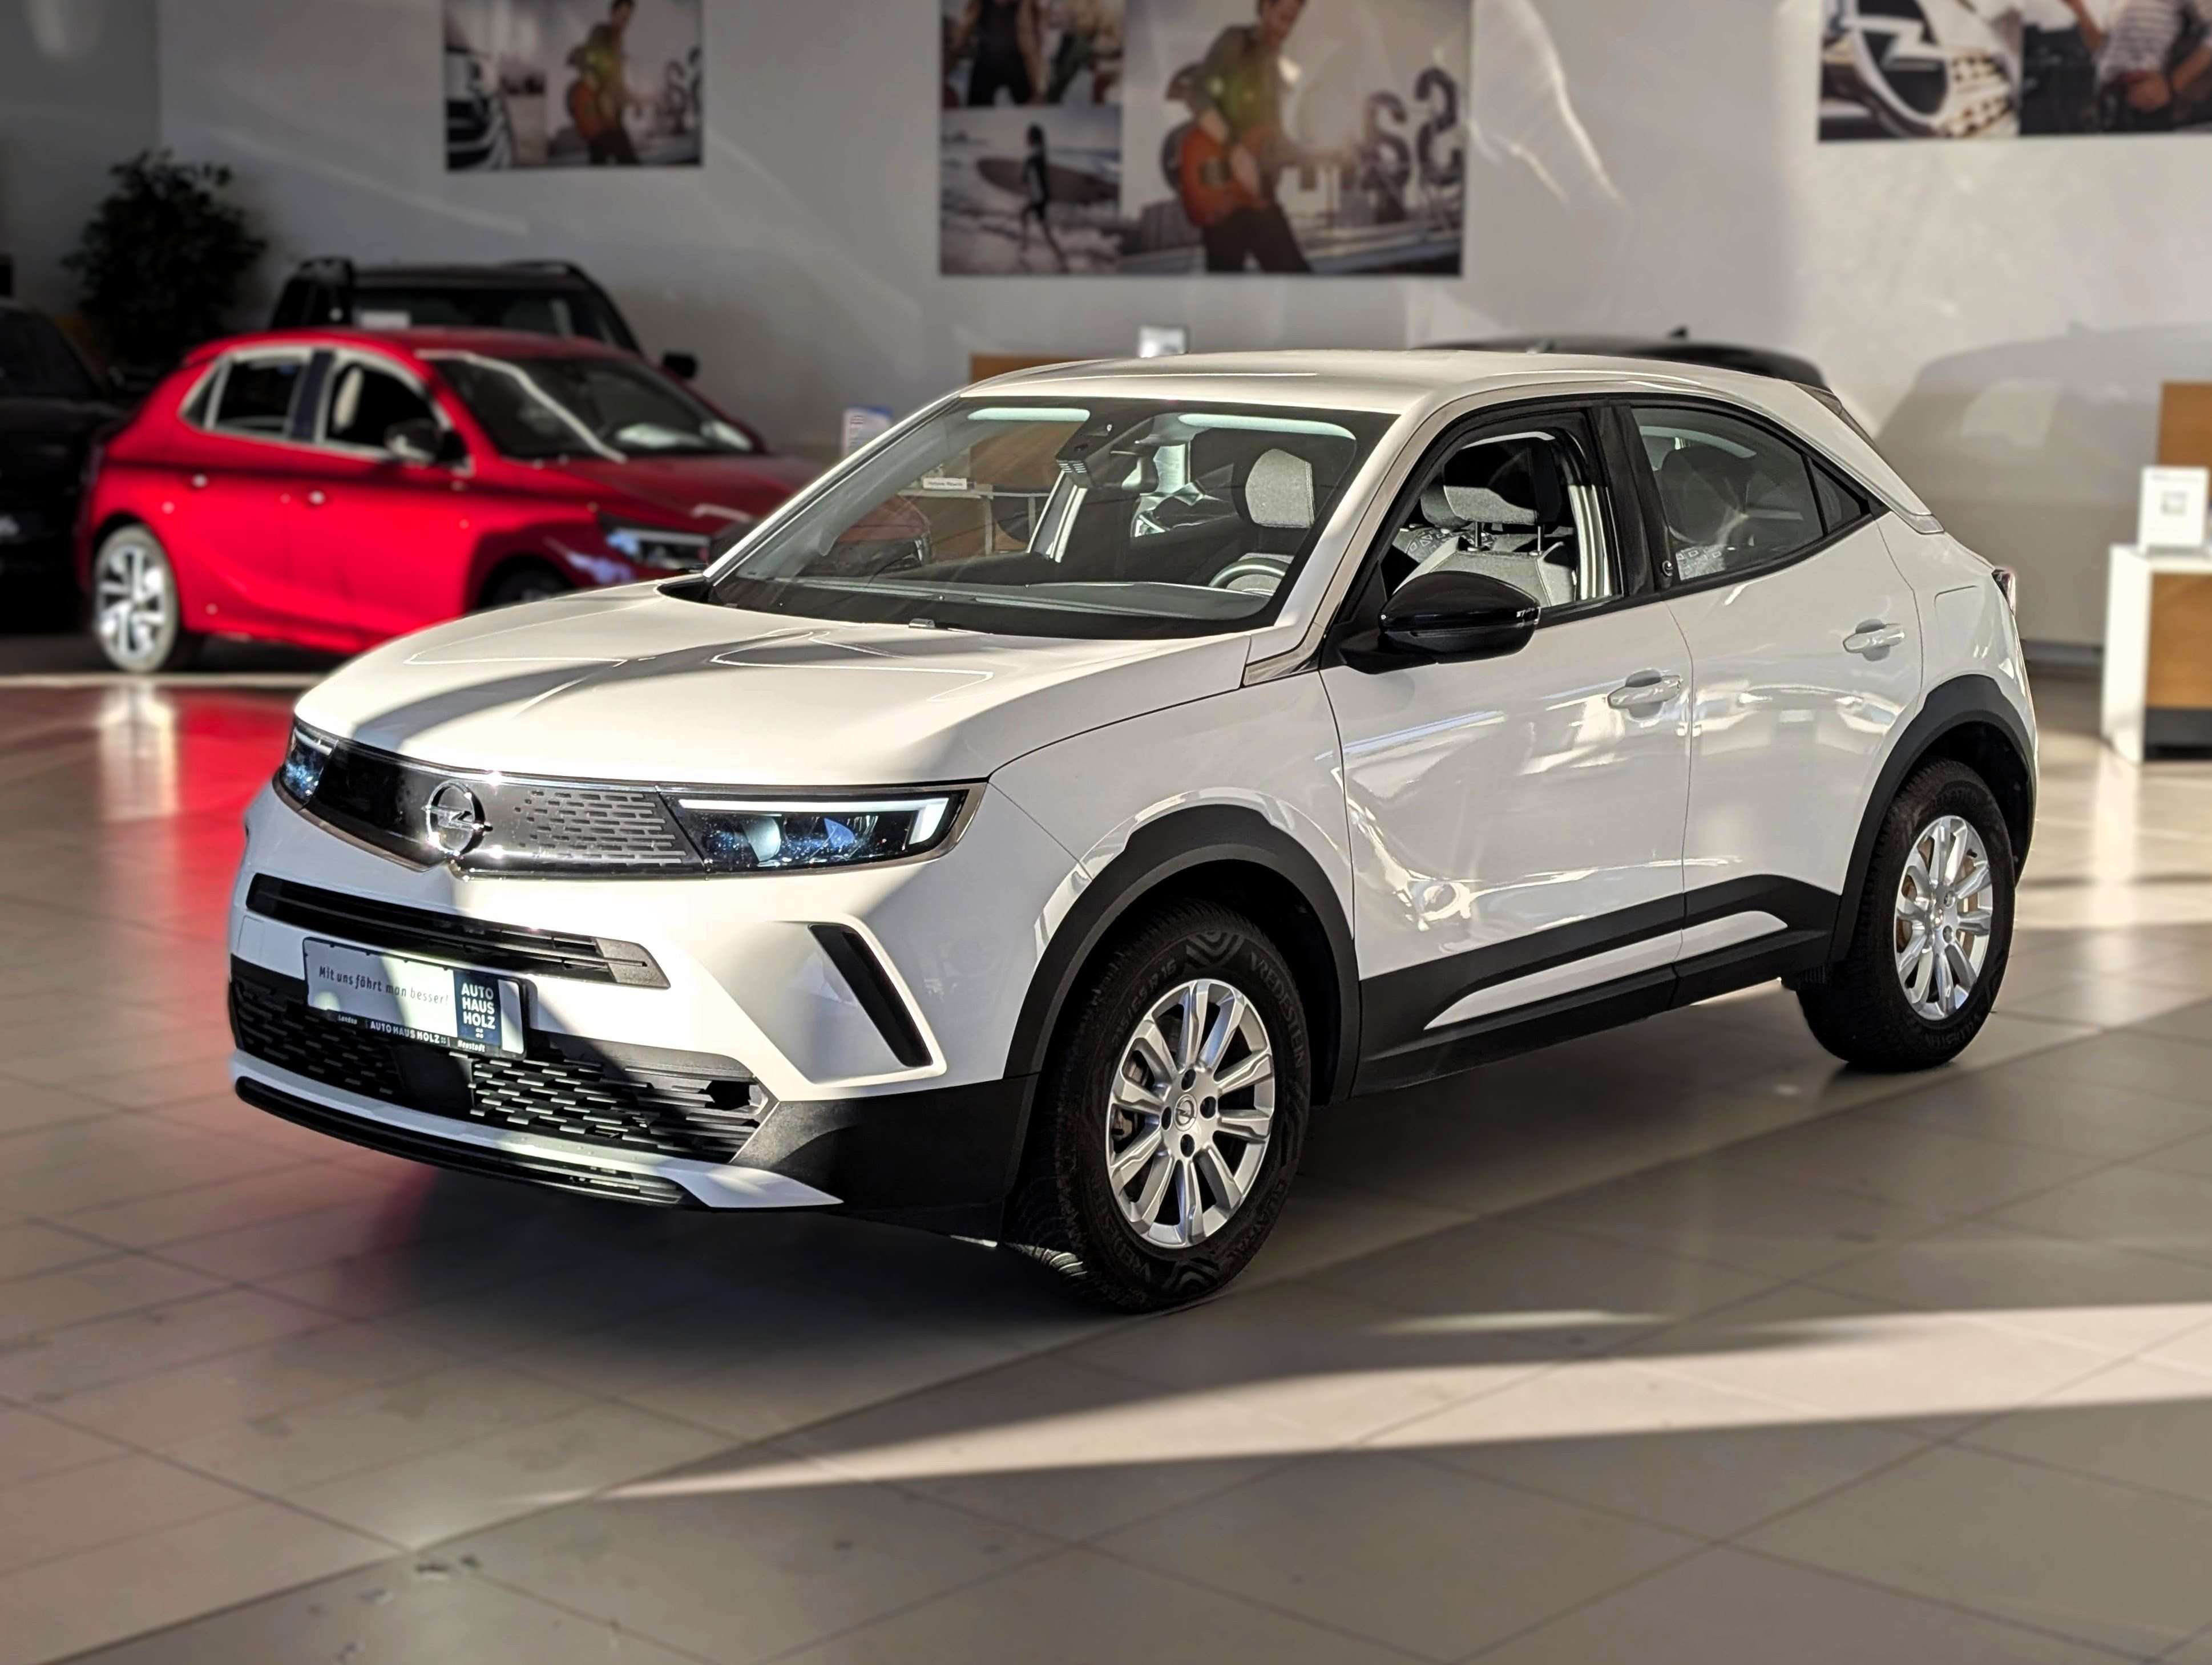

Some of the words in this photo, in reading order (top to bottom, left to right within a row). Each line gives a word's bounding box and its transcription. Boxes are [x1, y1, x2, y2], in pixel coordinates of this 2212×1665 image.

[319, 965, 334, 981] Mit
[337, 973, 353, 985] uns
[354, 974, 382, 992] fährt
[386, 983, 407, 997] man
[410, 987, 449, 1005] besser!
[461, 982, 494, 1000] AUTO
[462, 996, 495, 1015] HAUS
[1250, 951, 1305, 1068] VREDESTEIN
[463, 1011, 496, 1030] HOLZ
[370, 1021, 392, 1034] AUTO
[393, 1027, 417, 1039] HAUS
[417, 1030, 441, 1044] HOLZ
[457, 1039, 486, 1053] Neustadt
